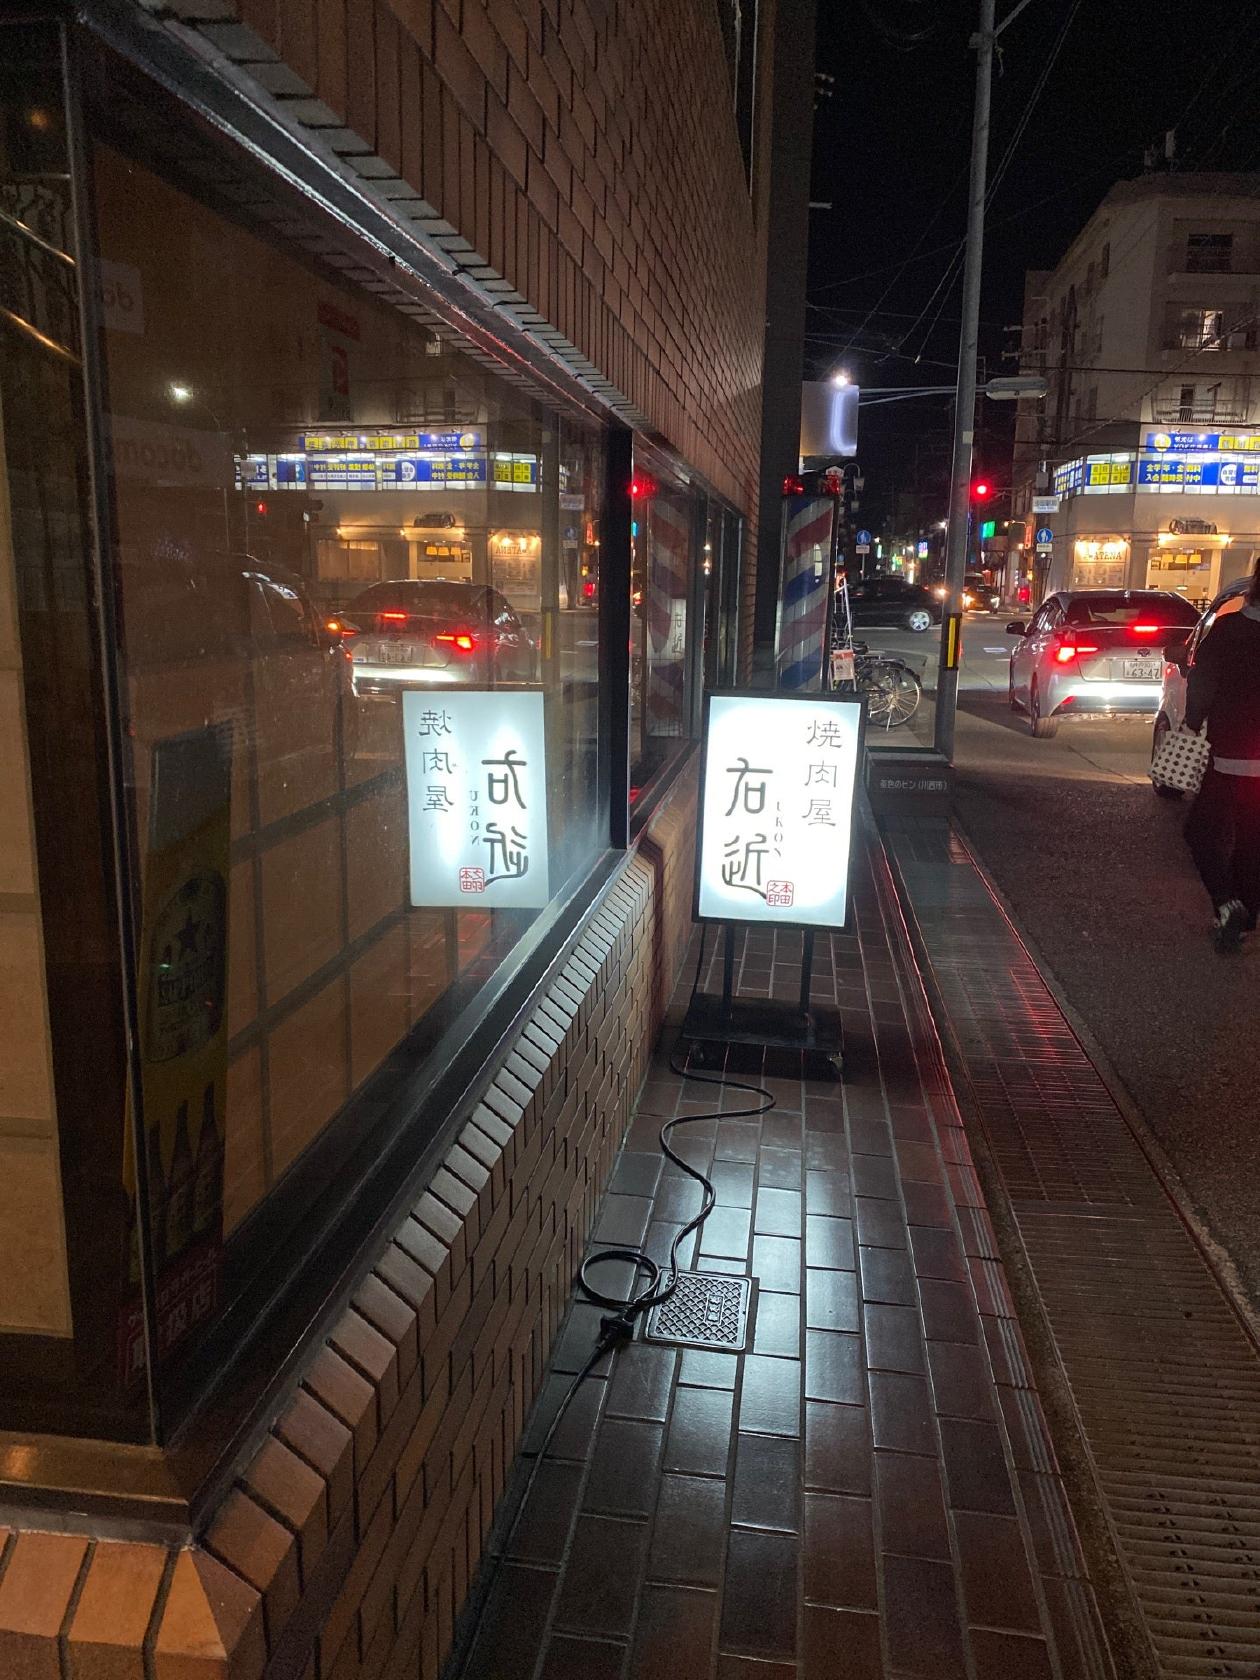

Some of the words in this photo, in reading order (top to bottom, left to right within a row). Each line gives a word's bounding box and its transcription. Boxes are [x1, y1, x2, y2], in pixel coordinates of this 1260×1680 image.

[721, 757, 774, 900] 右近
[801, 719, 843, 827] 焼肉屋
